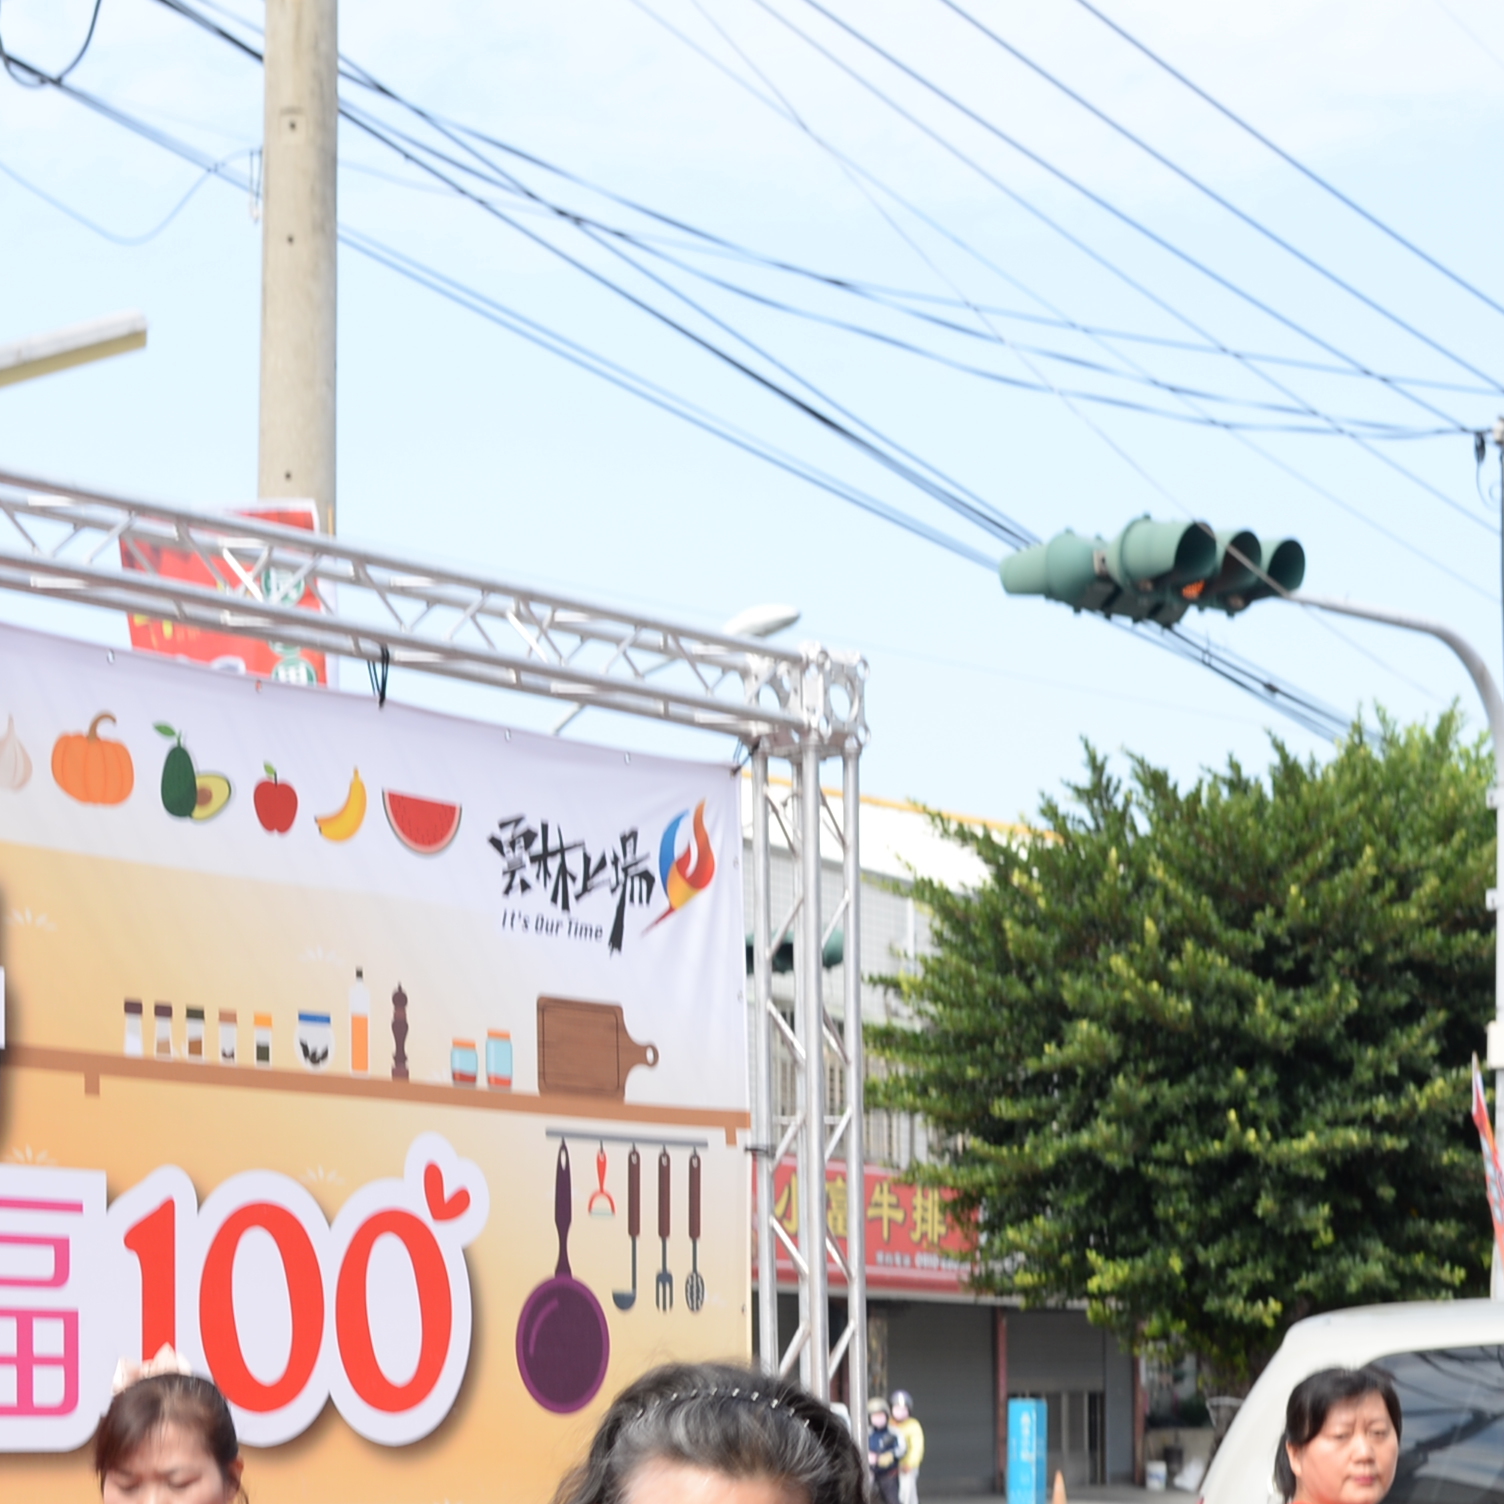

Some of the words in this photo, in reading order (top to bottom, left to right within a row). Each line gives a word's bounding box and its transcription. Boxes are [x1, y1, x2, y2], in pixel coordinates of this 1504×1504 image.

[488, 814, 656, 957] 雲林上場
[501, 908, 530, 933] It's
[535, 913, 561, 937] Our
[567, 917, 603, 943] Time
